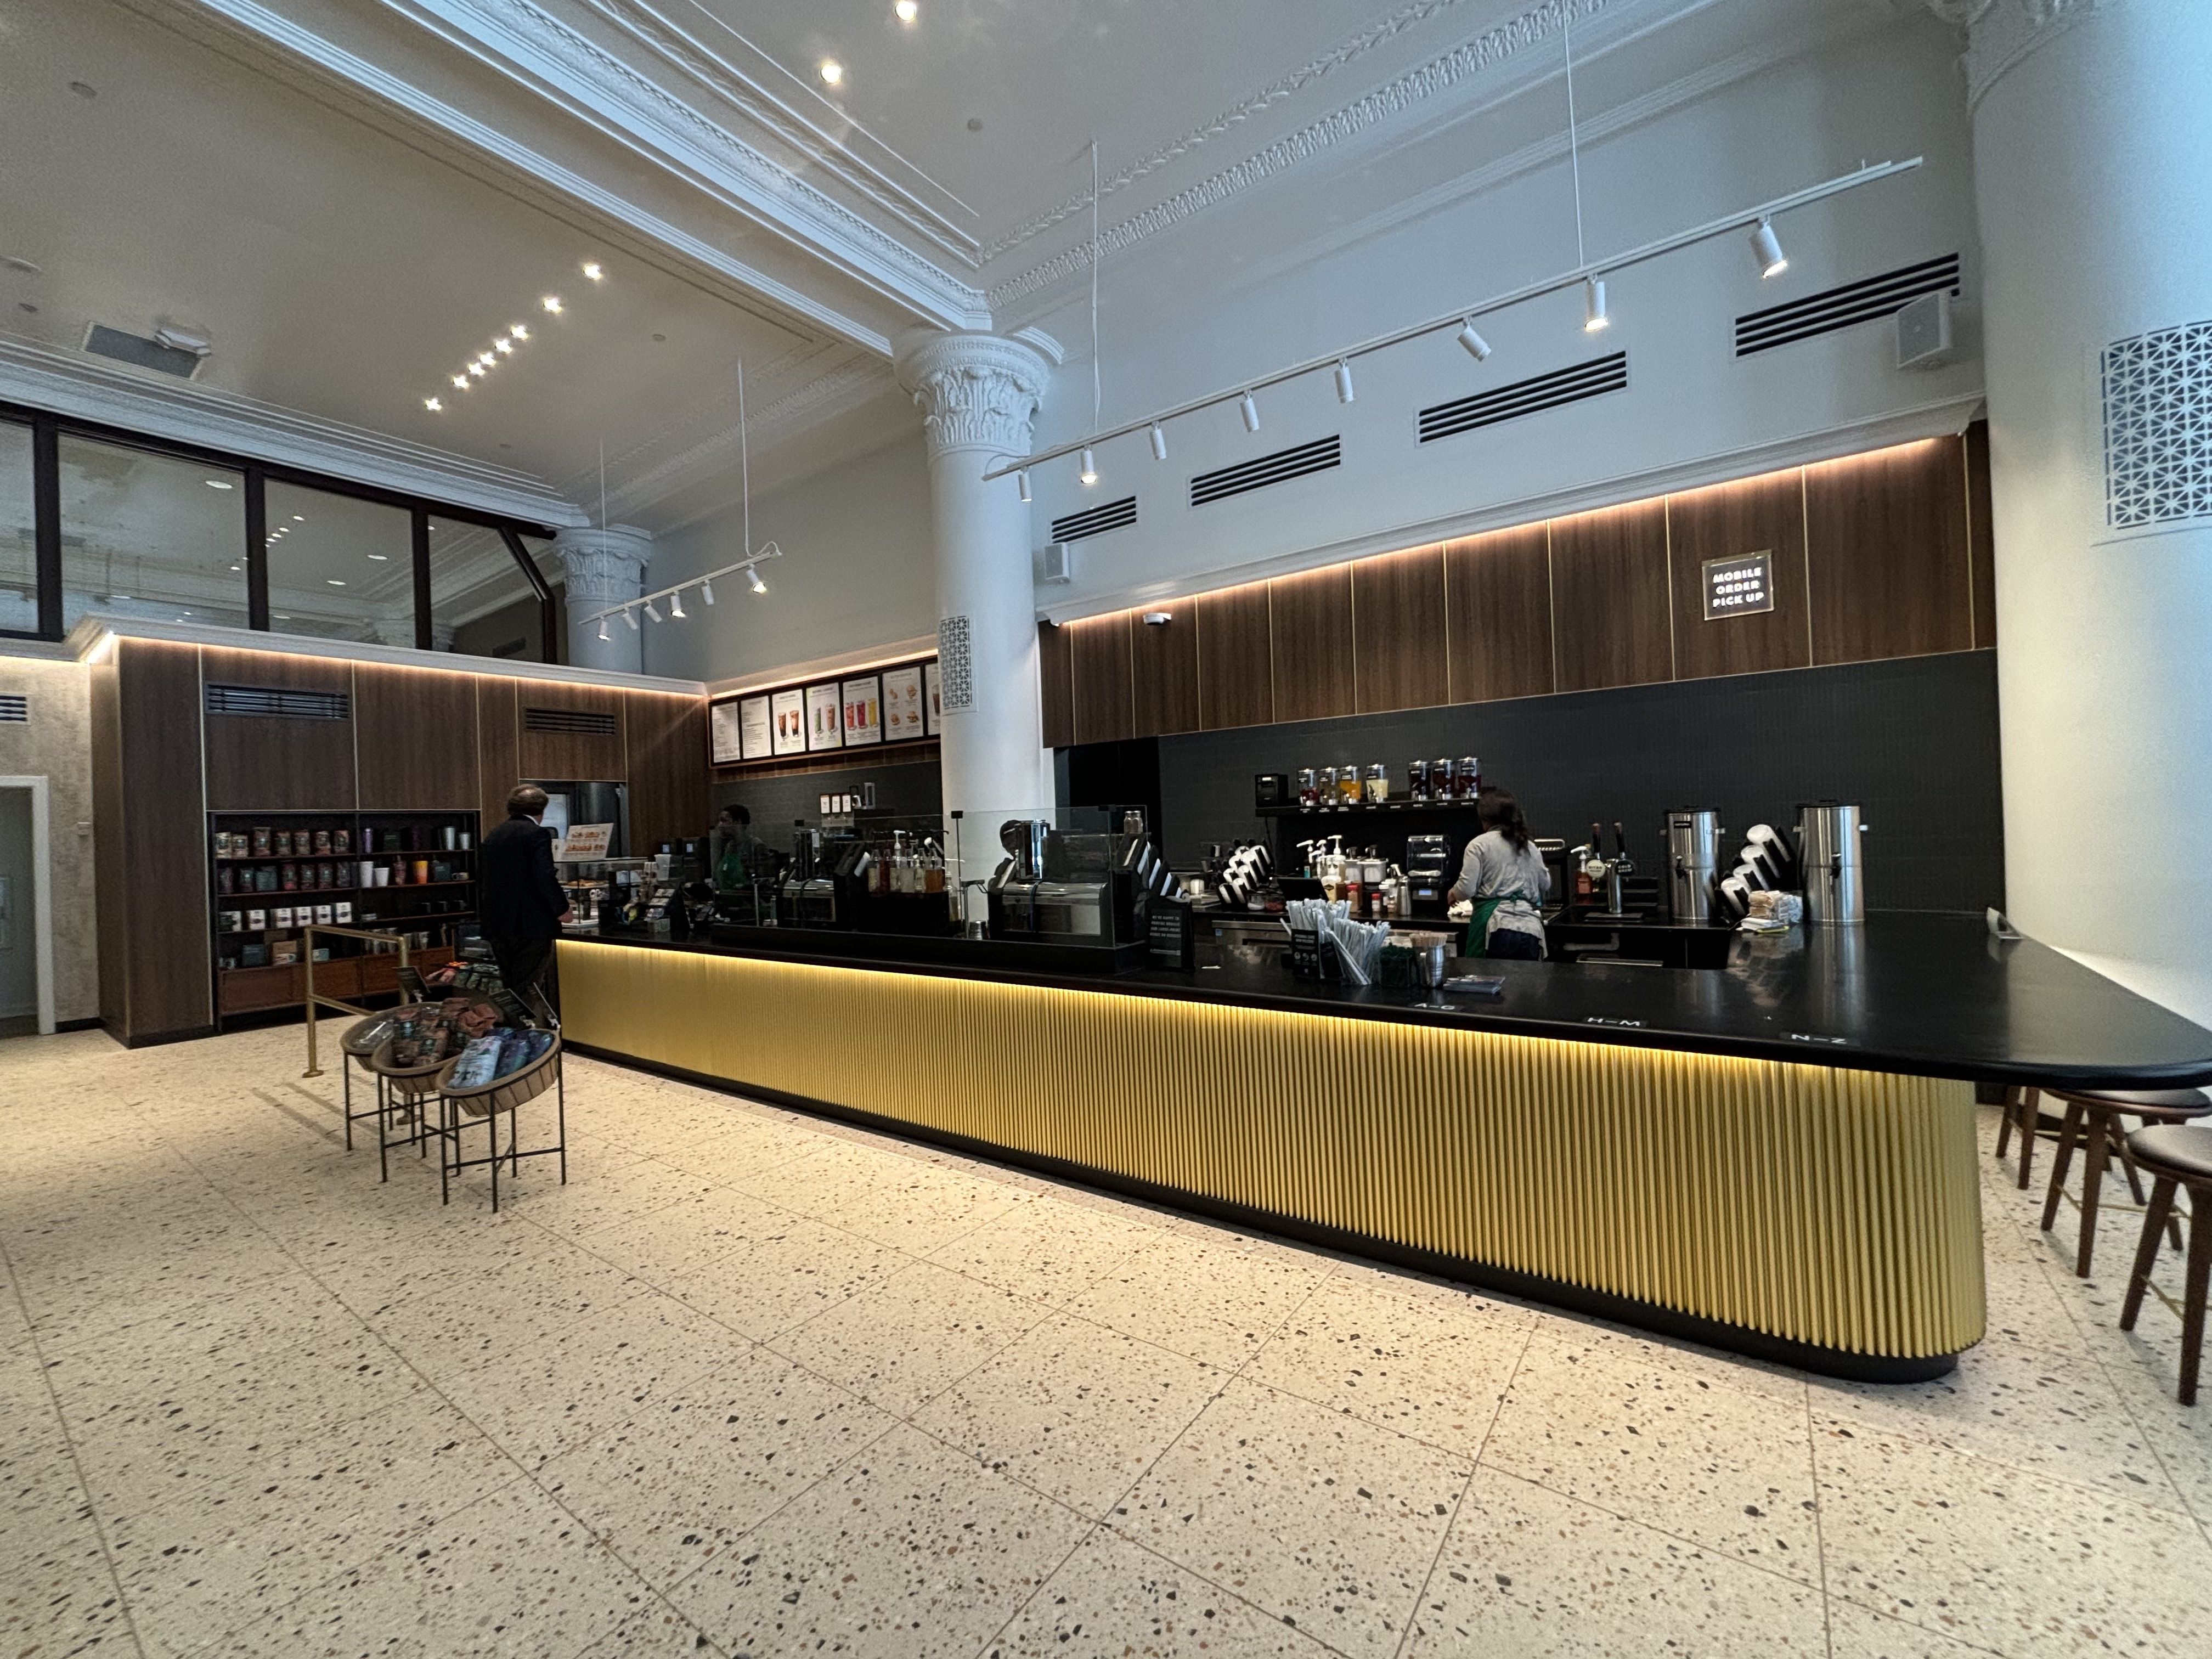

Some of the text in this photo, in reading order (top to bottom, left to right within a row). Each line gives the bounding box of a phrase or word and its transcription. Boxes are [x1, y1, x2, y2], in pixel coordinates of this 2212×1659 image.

[1713, 567, 1762, 583] MOBILE
[1716, 580, 1760, 595] ORDER
[1712, 591, 1764, 607] PICK UP
